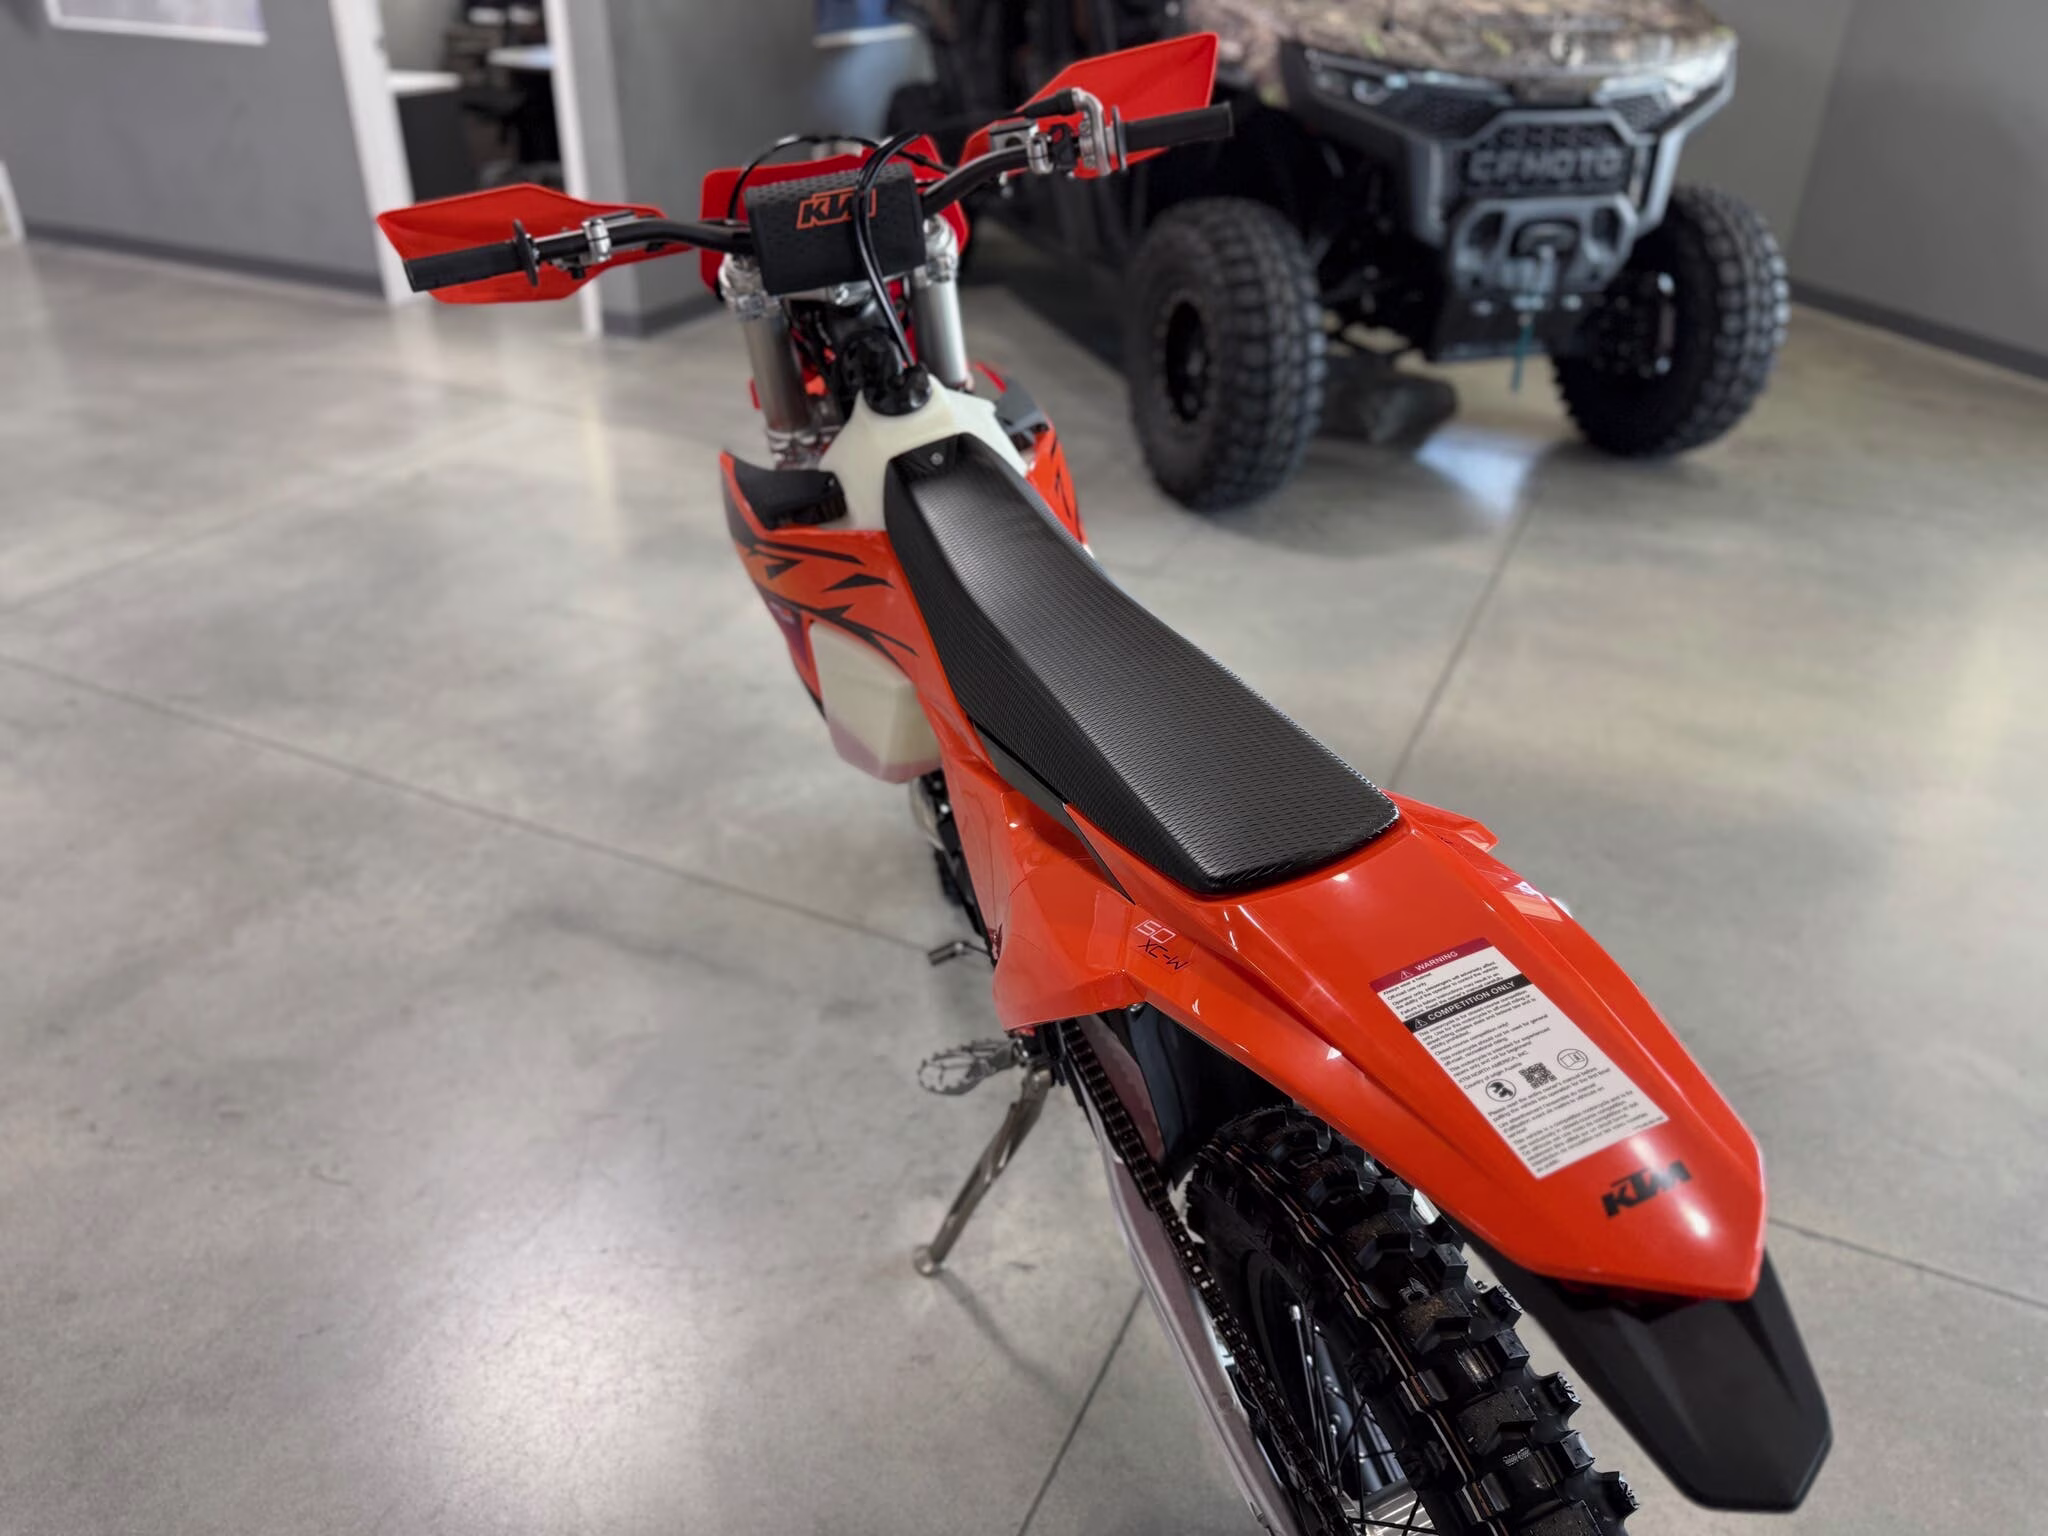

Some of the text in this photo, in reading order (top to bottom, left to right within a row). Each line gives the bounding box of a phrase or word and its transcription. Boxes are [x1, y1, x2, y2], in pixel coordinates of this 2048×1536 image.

[1137, 939, 1189, 970] XC-W
[1415, 951, 1458, 972] WARNING
[1427, 980, 1516, 1021] COMPETITION ONLY
[1601, 1160, 1692, 1217] KTM
